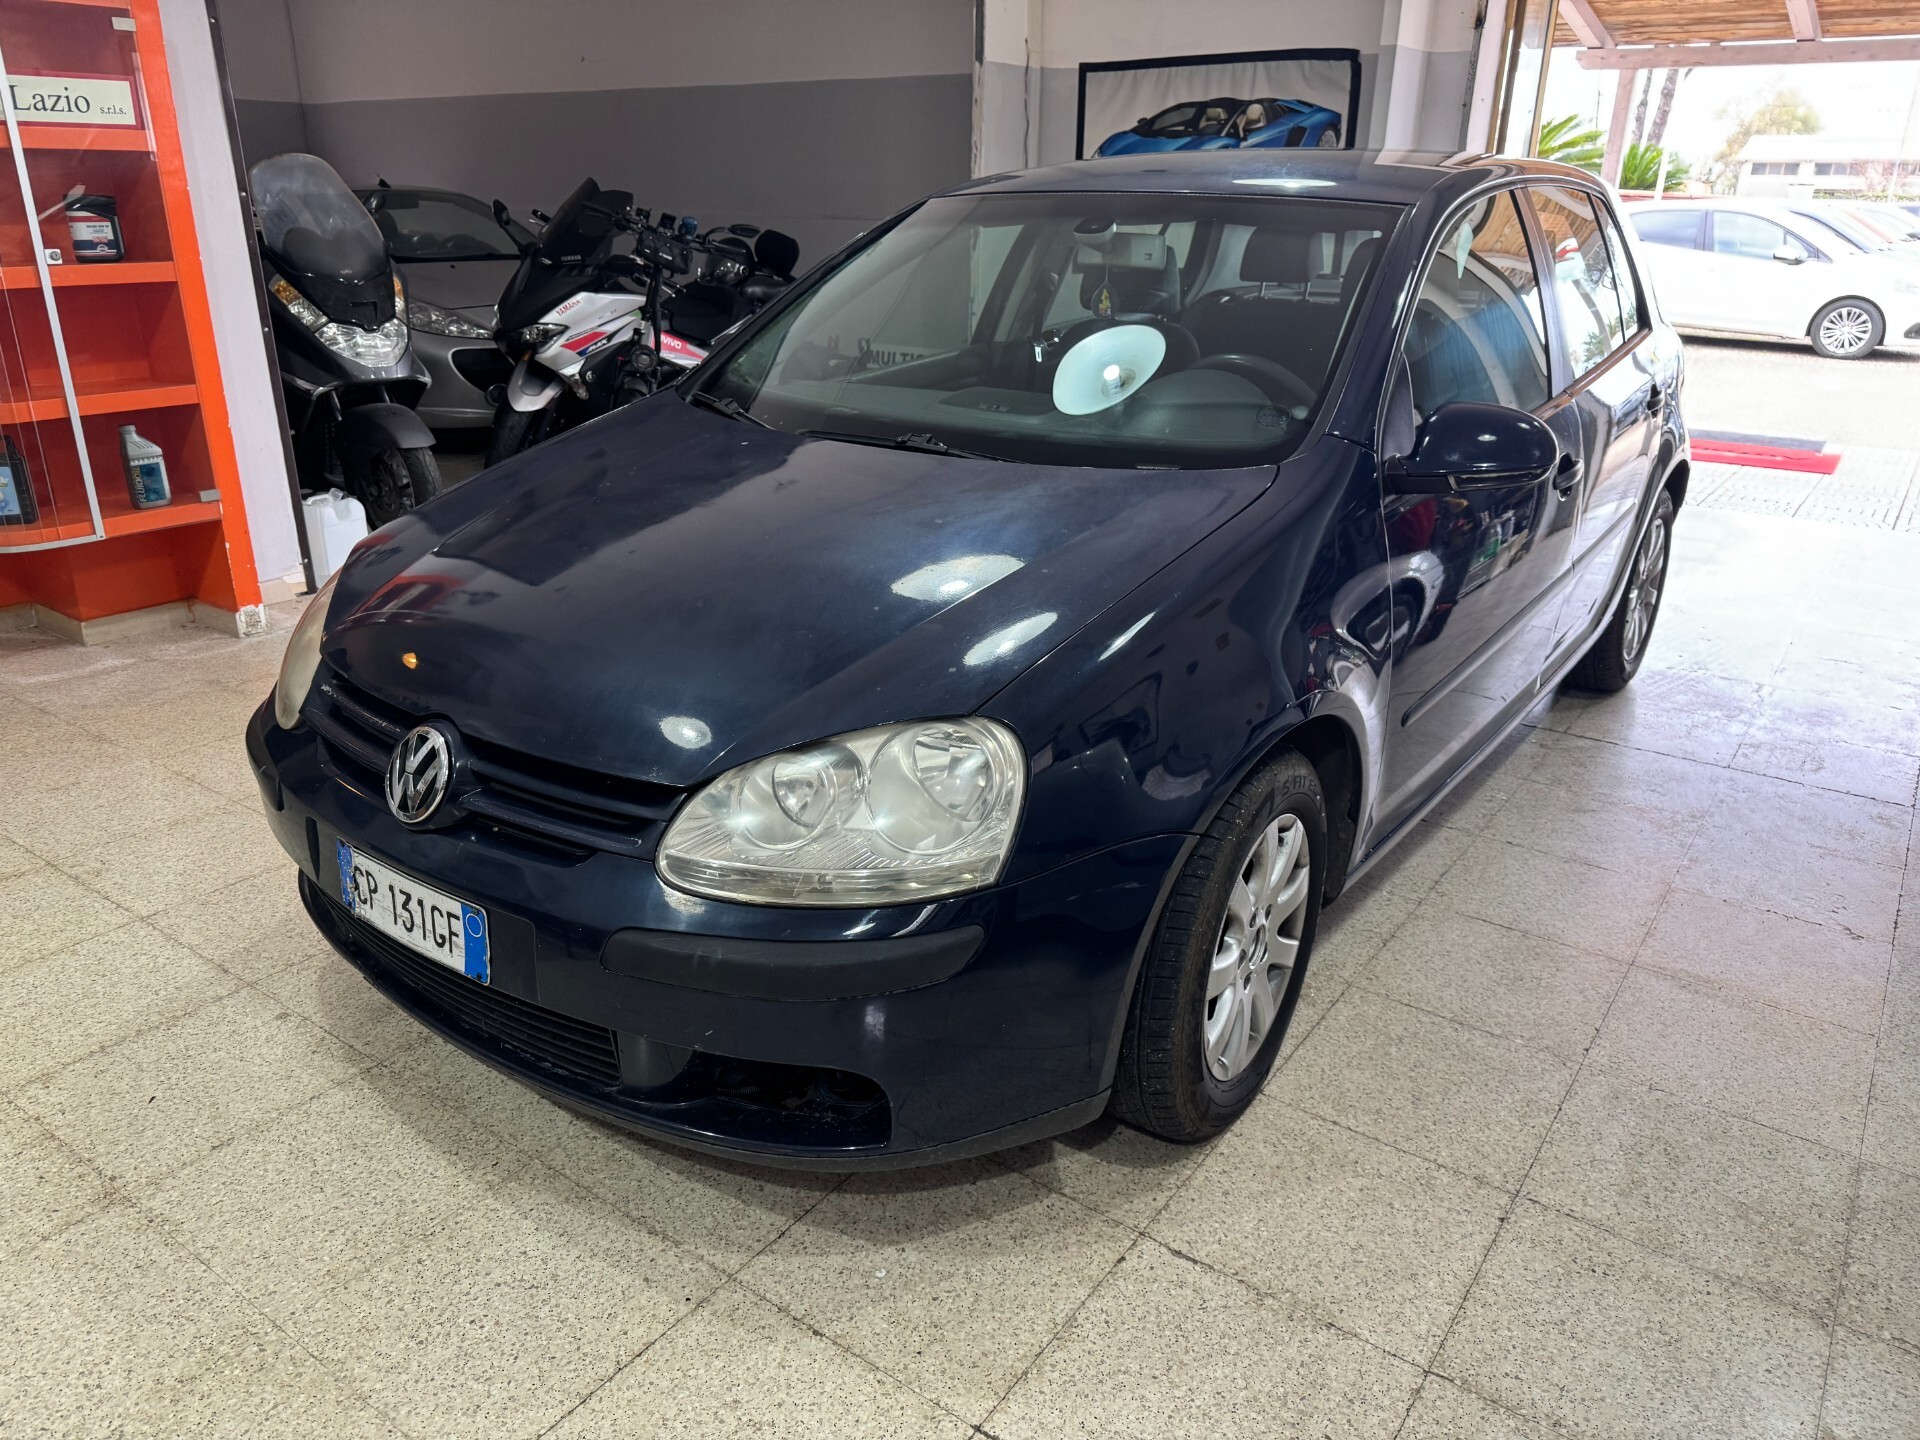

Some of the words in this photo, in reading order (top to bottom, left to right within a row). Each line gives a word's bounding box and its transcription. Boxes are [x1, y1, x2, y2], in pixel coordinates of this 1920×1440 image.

[9, 84, 91, 114] Lazio
[99, 104, 127, 115] s.r.l.s.
[556, 300, 581, 317] YAMAHA
[388, 884, 461, 954] 131GF
